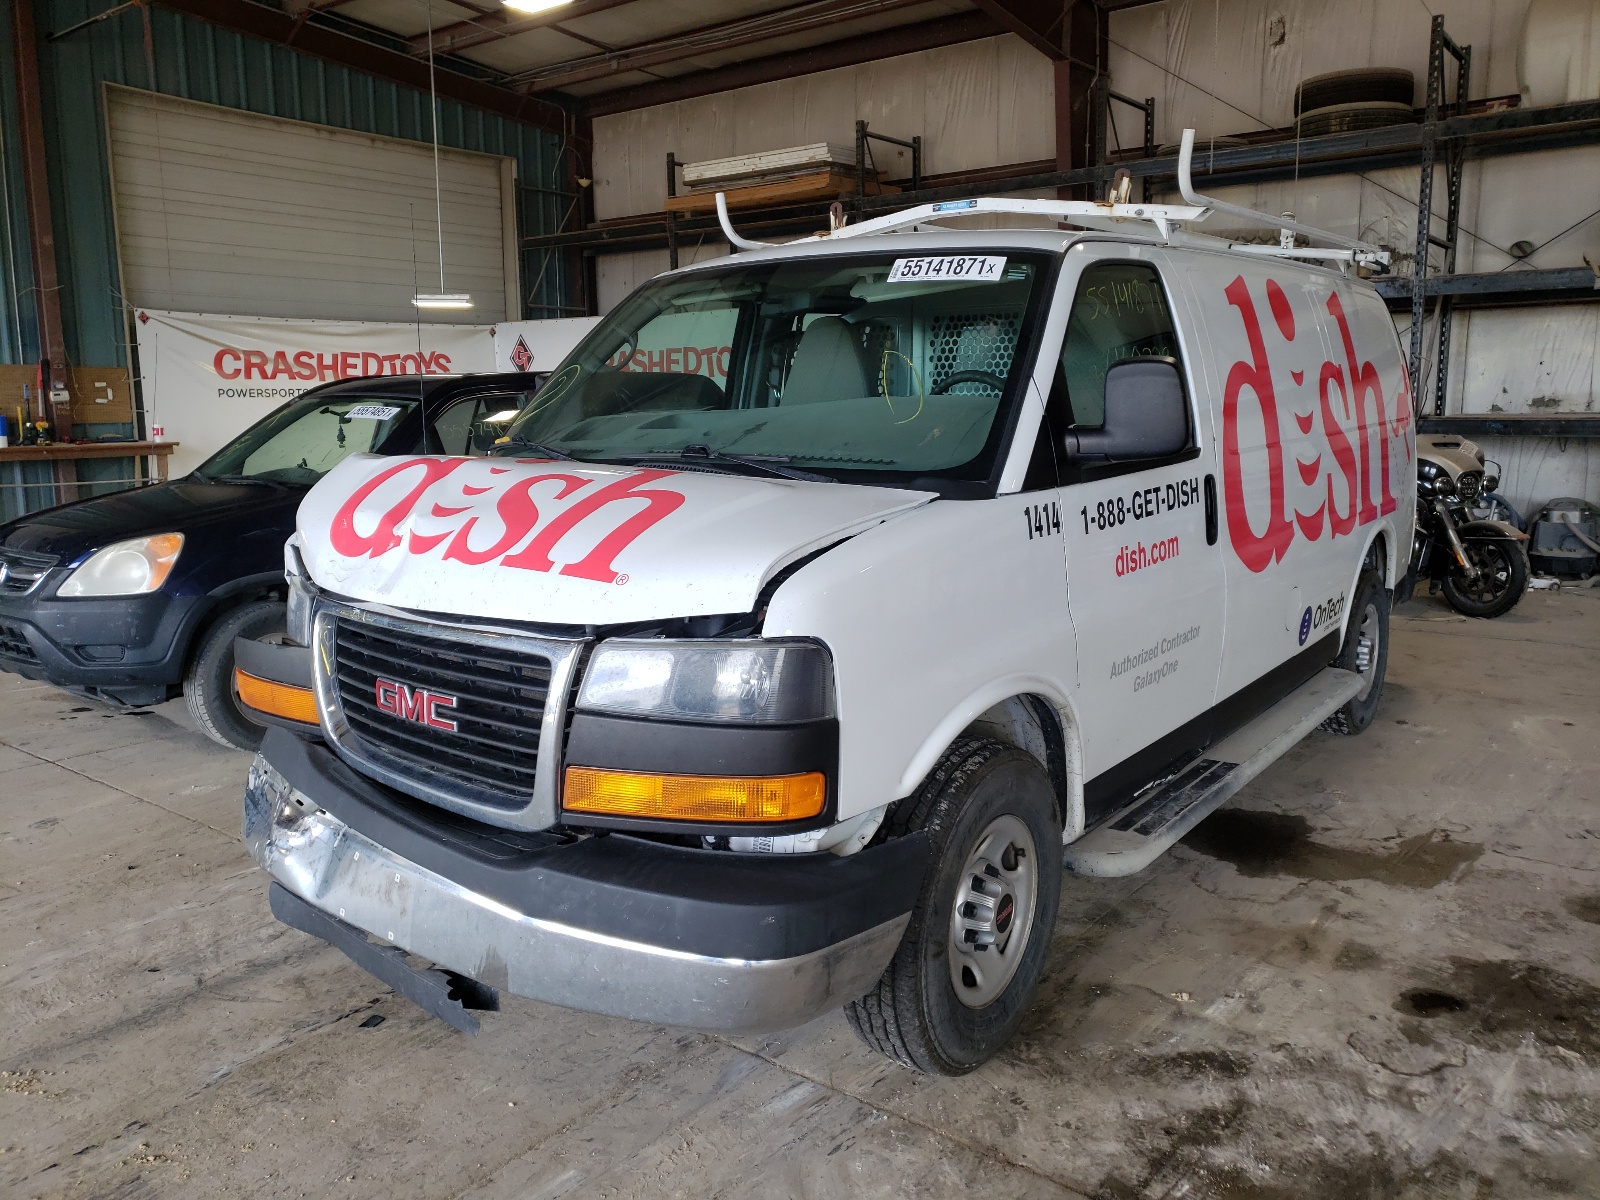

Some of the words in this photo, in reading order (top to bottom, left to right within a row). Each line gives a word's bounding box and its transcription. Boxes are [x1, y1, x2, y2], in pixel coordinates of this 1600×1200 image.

[901, 257, 987, 276] 55141871
[213, 348, 452, 382] CRASHEDTOYS
[1223, 275, 1396, 573] dish
[1024, 501, 1061, 540] 1414
[1081, 477, 1200, 535] 1-888-GET-DISH
[1115, 536, 1180, 577] dish.com
[1314, 591, 1345, 630] OnTech
[1110, 641, 1159, 680] Authorized
[1160, 625, 1201, 655] Contractor
[1133, 659, 1179, 693] GalaxyOne
[375, 676, 459, 733] GMC
